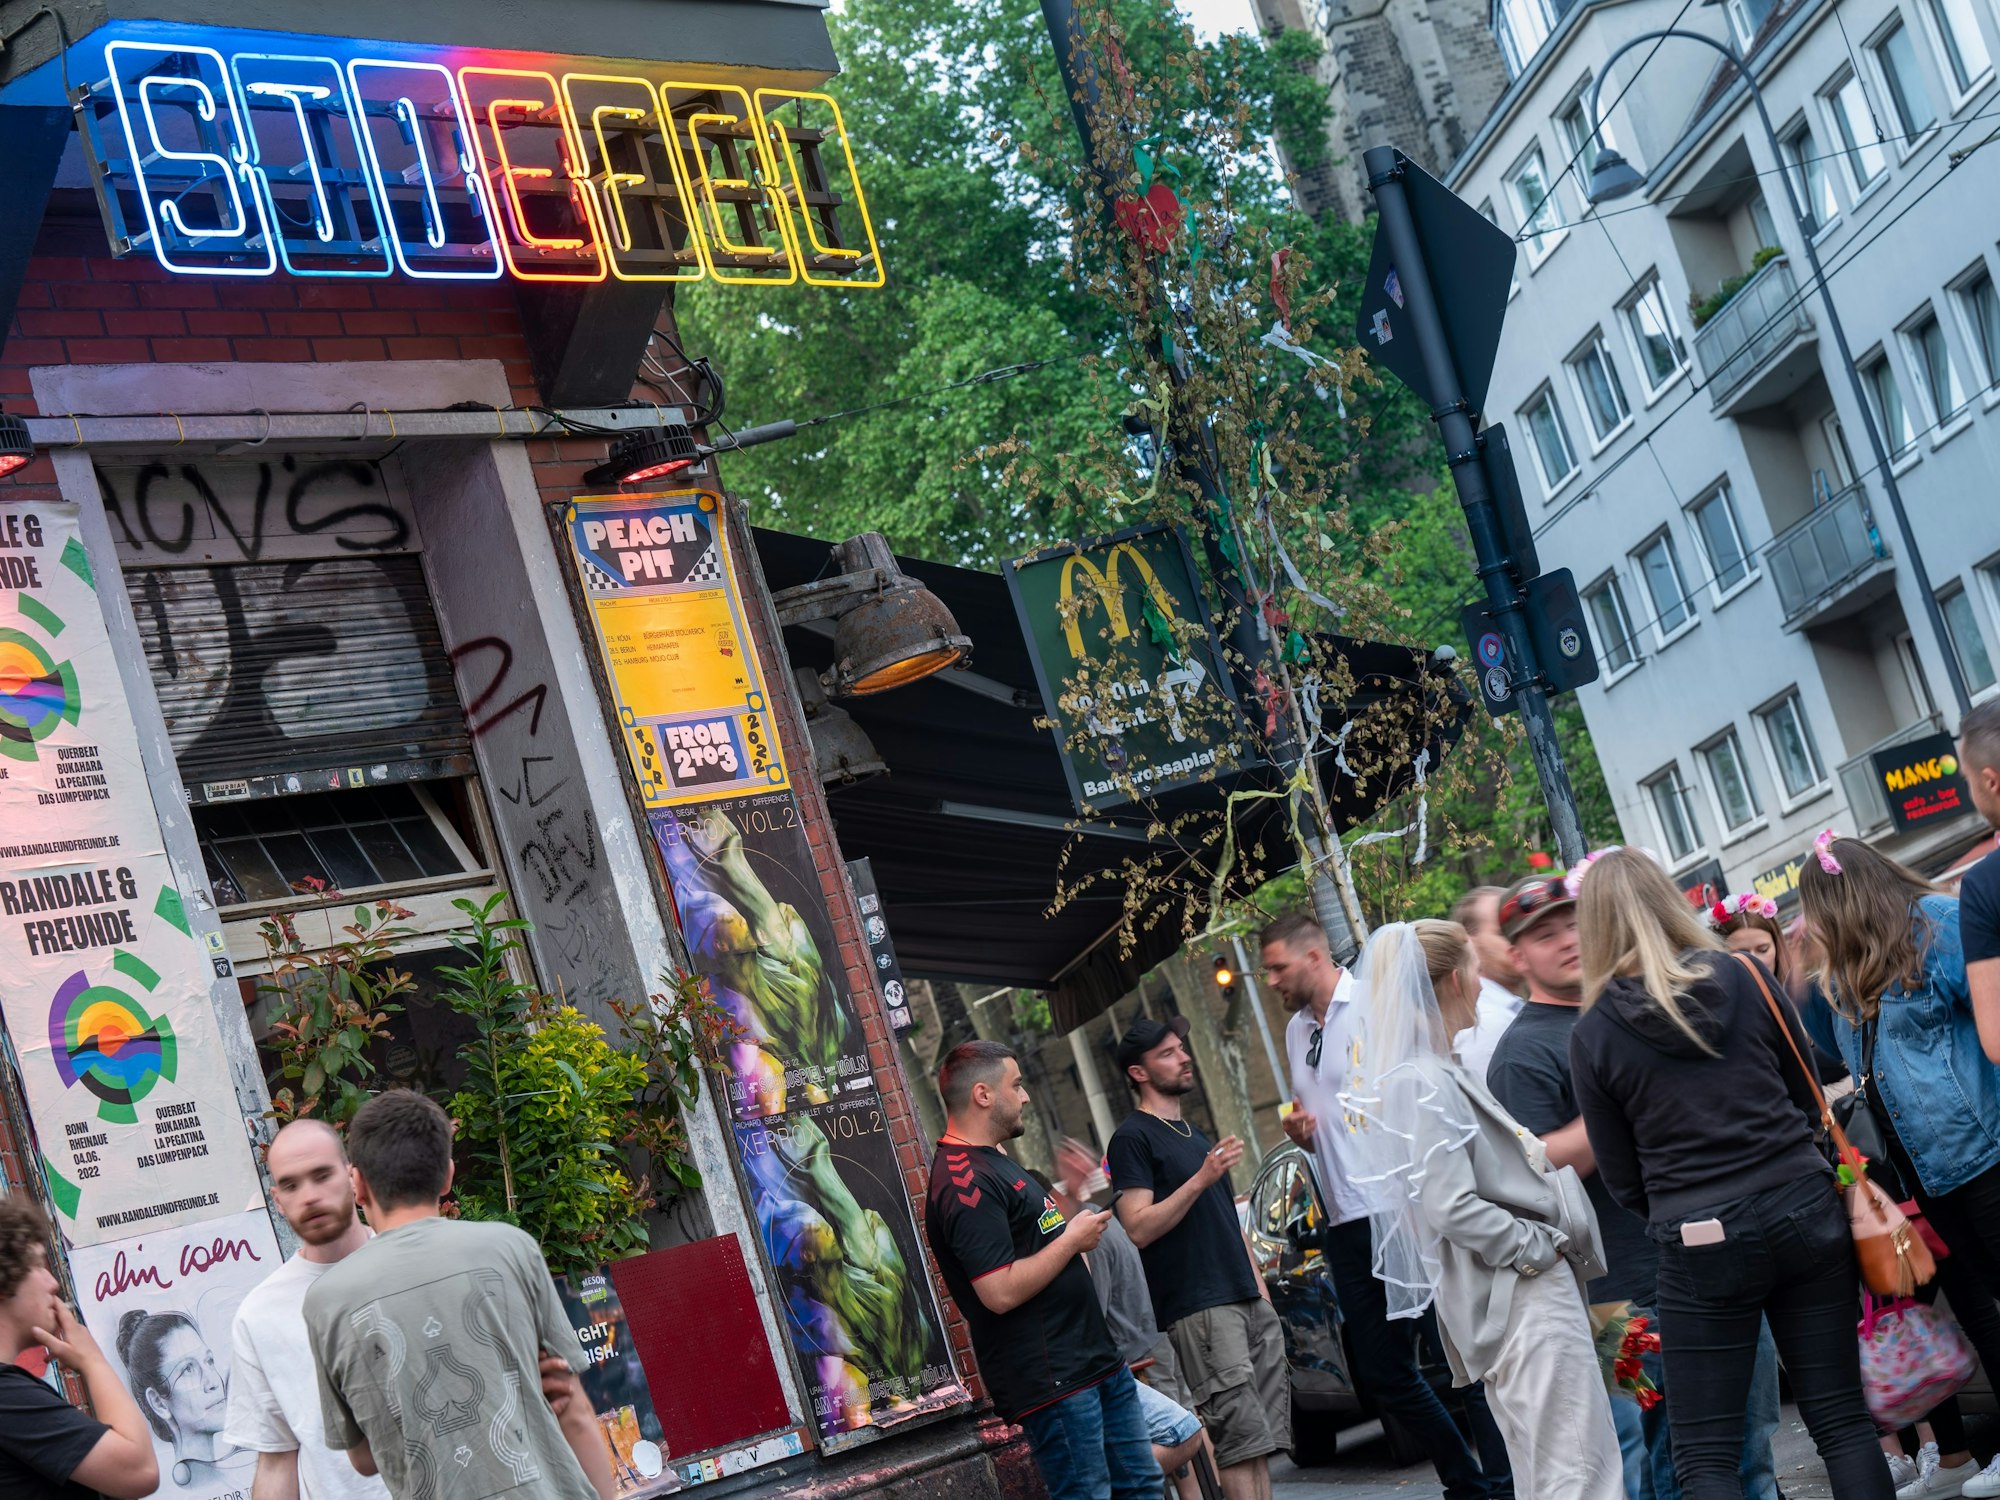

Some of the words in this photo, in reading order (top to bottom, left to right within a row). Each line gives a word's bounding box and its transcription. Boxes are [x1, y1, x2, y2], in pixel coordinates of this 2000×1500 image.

[134, 72, 866, 262] STIEFEL
[24, 514, 44, 547] &
[582, 513, 697, 551] PEACH
[618, 548, 674, 581] PIT
[643, 629, 675, 640] BÜRGERHAUS
[647, 642, 679, 651] HEIMATHAFEN
[624, 656, 649, 664] HAMBURG
[650, 655, 667, 663] MOJO
[667, 653, 680, 661] CLUB
[665, 721, 731, 750] FROM
[747, 714, 766, 774] 2022
[56, 760, 103, 774] BUKAHARA
[58, 746, 99, 761] QUERBEAT
[634, 728, 663, 785] TOUR
[55, 777, 67, 789] LA
[67, 774, 107, 788] PEGATINA
[1886, 753, 1957, 792] MANGO
[38, 793, 56, 805] DAS
[55, 788, 110, 803] LUMPENPACK
[648, 810, 673, 820] RICHARD
[676, 807, 697, 817] SIEGAL
[712, 802, 733, 811] BALLET
[739, 800, 747, 808] OF
[753, 793, 789, 806] DIFFERENCE
[1906, 796, 1960, 820] restaurant
[653, 816, 733, 847] XERROX
[0, 869, 117, 916] RANDALE
[116, 866, 138, 900] &
[23, 909, 138, 956] FREUNDE
[760, 1064, 825, 1094] SCHAUSPIEL
[836, 1055, 869, 1077] KÖLN
[155, 1101, 197, 1120] QUERBEAT
[735, 1119, 761, 1130] RICHARD
[764, 1115, 786, 1125] SIEGAL
[800, 1107, 821, 1118] BALLET
[826, 1105, 834, 1113] OF
[840, 1097, 876, 1111] DIFFERENCE
[65, 1121, 89, 1136] BONN
[155, 1116, 201, 1135] BUKAHARA
[739, 1121, 820, 1157] XERROX
[69, 1133, 109, 1151] RHEINAUE
[154, 1138, 166, 1150] LA
[165, 1130, 205, 1148] PEGATINA
[73, 1151, 101, 1165] 04.06.
[137, 1155, 156, 1169] DAS
[155, 1144, 209, 1165] LUMPENPACK
[77, 1166, 101, 1180] 2022
[97, 1193, 220, 1229] WWW.RANDALEUNDFREUNDE.DE
[95, 1243, 173, 1301] alin
[180, 1237, 261, 1277] coen
[813, 1396, 832, 1416] AM
[843, 1376, 911, 1407] SCHAUSPIEL
[920, 1363, 951, 1387] KÖLN
